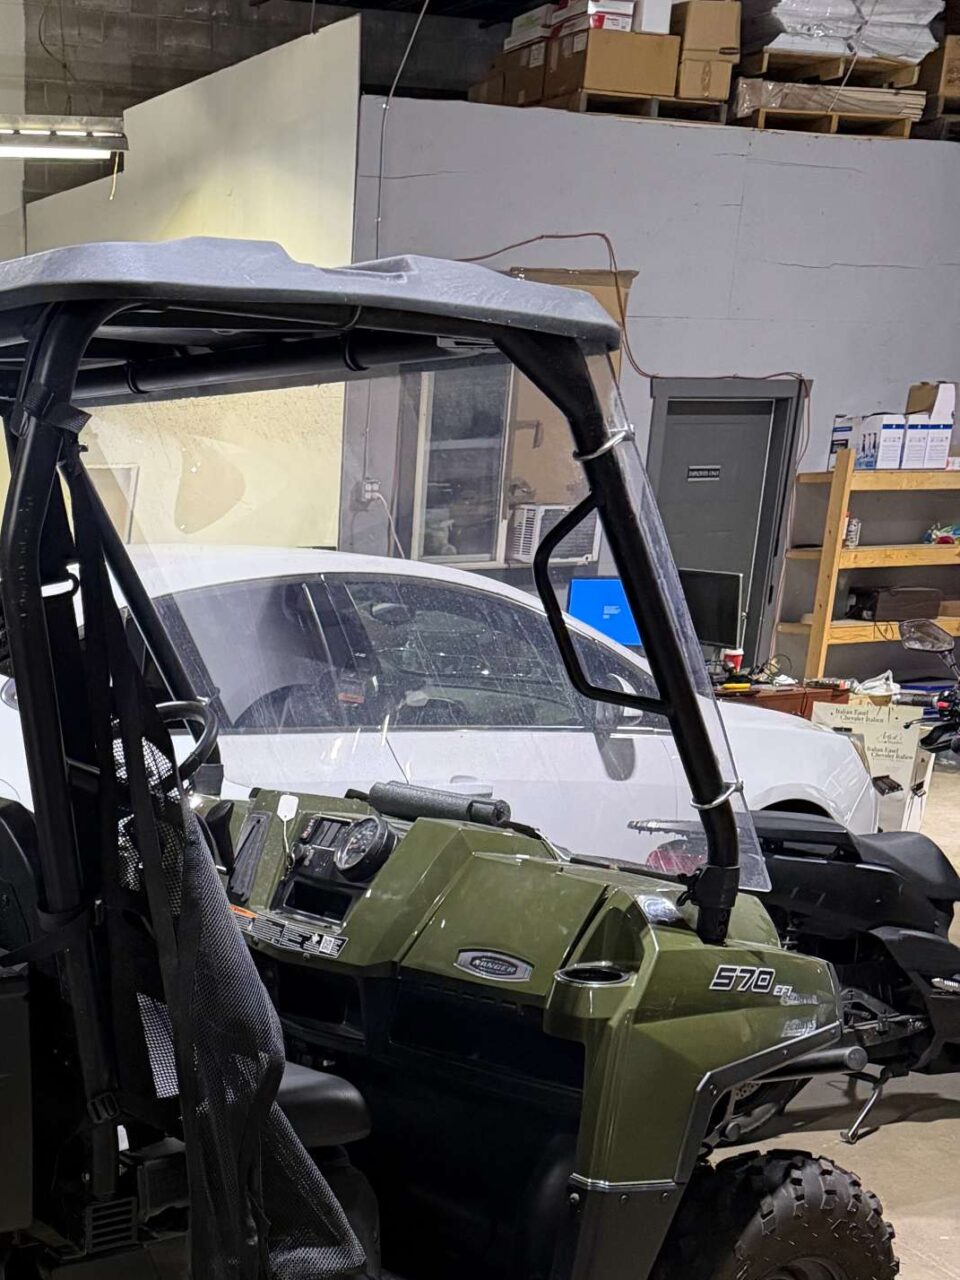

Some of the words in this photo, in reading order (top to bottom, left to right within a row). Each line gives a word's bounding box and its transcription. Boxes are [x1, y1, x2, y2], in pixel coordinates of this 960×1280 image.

[472, 958, 517, 974] RANGER
[709, 964, 775, 993] 570
[773, 985, 793, 996] EFI
